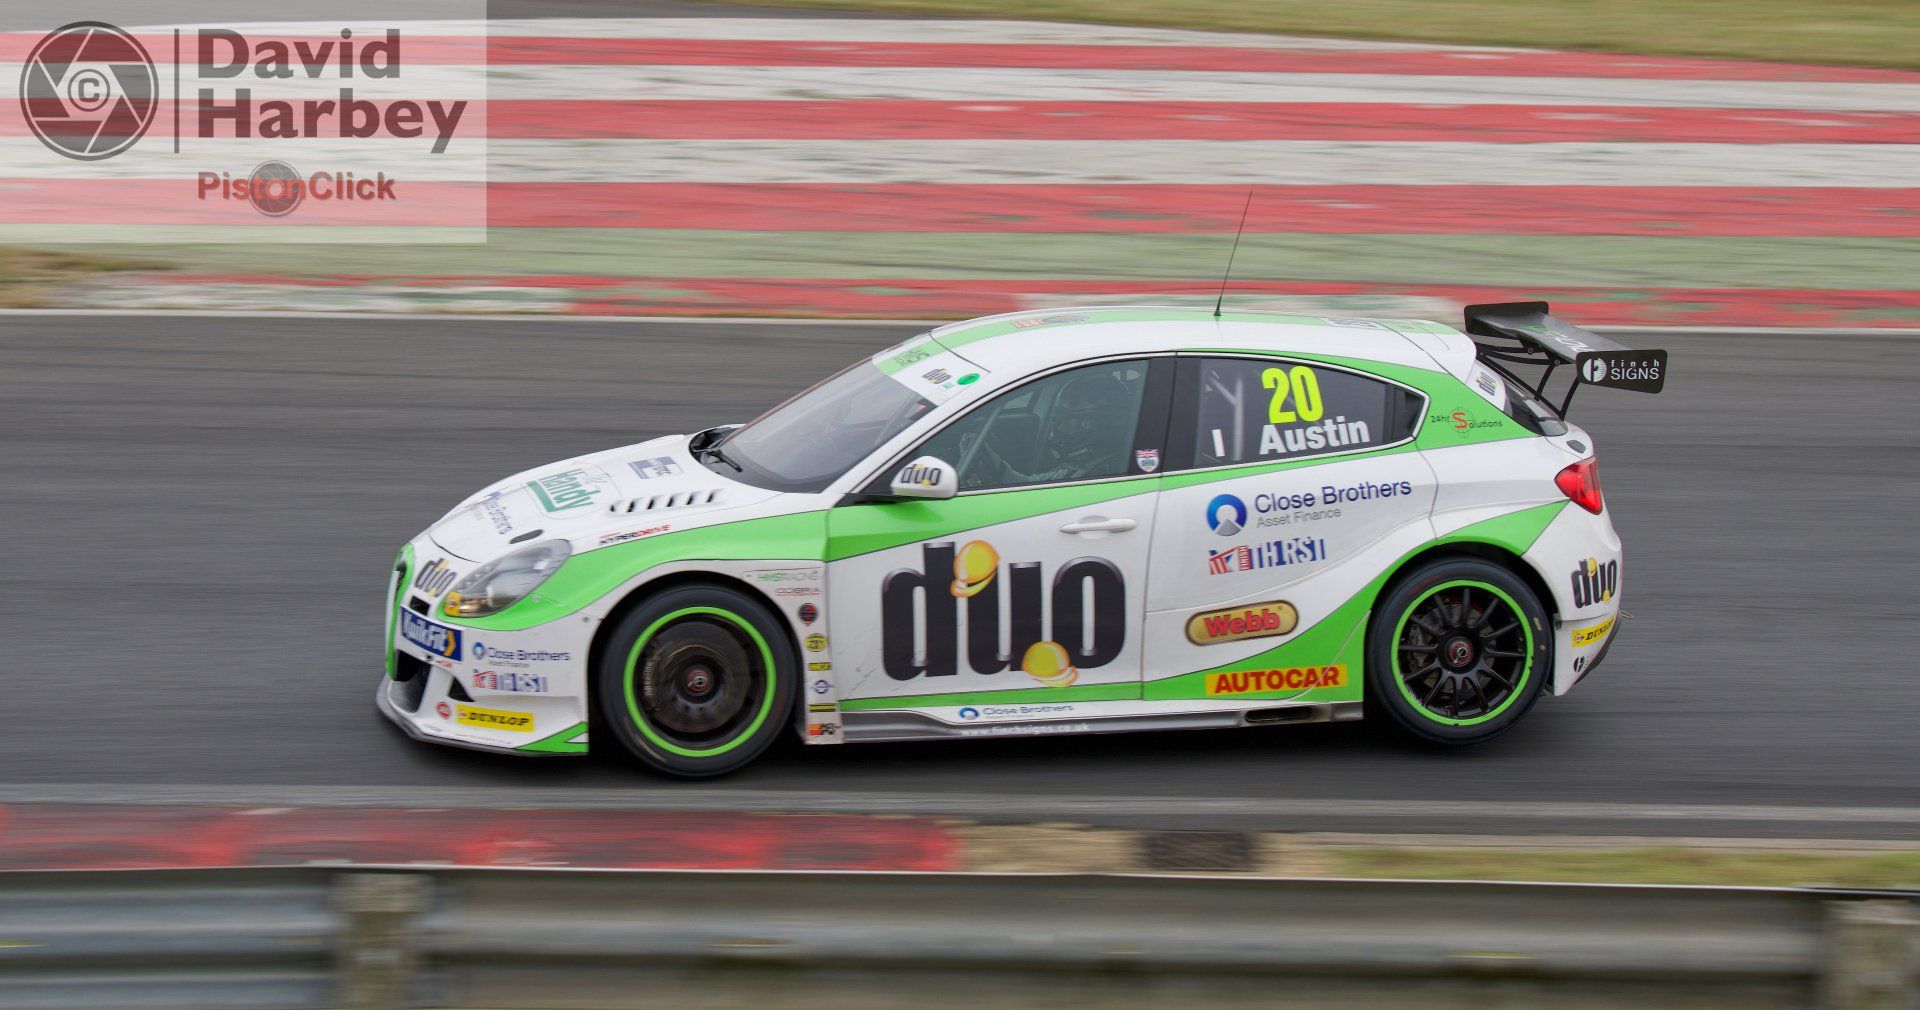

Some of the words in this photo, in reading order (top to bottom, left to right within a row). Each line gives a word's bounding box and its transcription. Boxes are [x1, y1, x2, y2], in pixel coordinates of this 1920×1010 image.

[1610, 368, 1660, 380] SIGNS
[1611, 359, 1660, 367] finch
[1261, 365, 1324, 424] 20
[1211, 428, 1226, 458] I
[1258, 415, 1371, 456] Austin
[900, 463, 942, 486] duo
[538, 468, 601, 511] Handy
[1255, 492, 1316, 514] Close
[1321, 481, 1413, 506] Brothers
[1256, 513, 1292, 529] Asset
[1293, 507, 1342, 524] Finance
[415, 558, 458, 597] duo
[1571, 558, 1617, 608] duo
[882, 541, 1126, 683] duo
[1203, 608, 1281, 638] Webb
[487, 647, 515, 660] Close
[516, 650, 572, 661] Brothers
[1213, 666, 1340, 694] AUTOCAR
[468, 712, 530, 726] DUNLOP
[982, 706, 1017, 715] Close
[1020, 704, 1074, 714] Brothers
